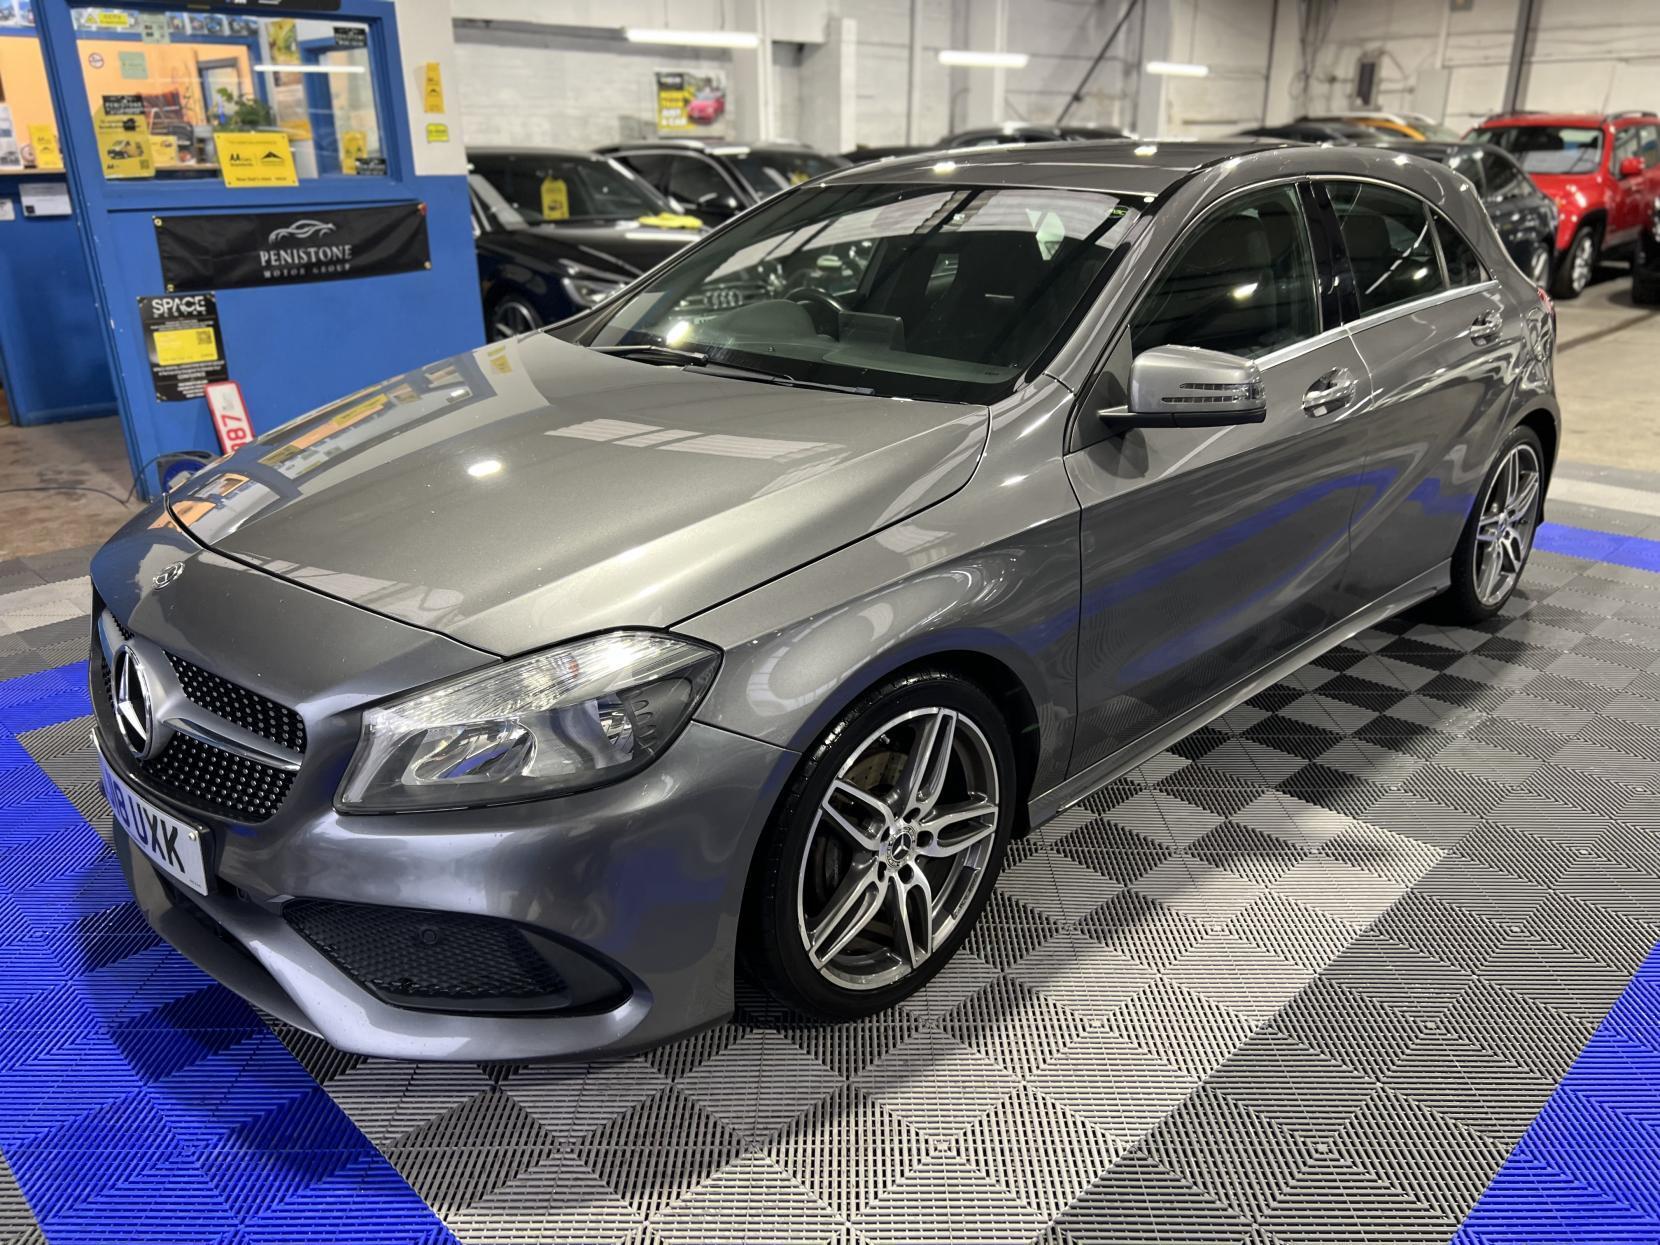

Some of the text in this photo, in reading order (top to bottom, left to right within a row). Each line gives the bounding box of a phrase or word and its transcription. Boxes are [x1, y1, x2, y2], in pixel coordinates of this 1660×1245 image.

[260, 245, 352, 266] PENISTONE
[263, 263, 351, 279] MOTOR GROUP
[152, 296, 206, 314] SPACE
[128, 794, 186, 875] UXK
